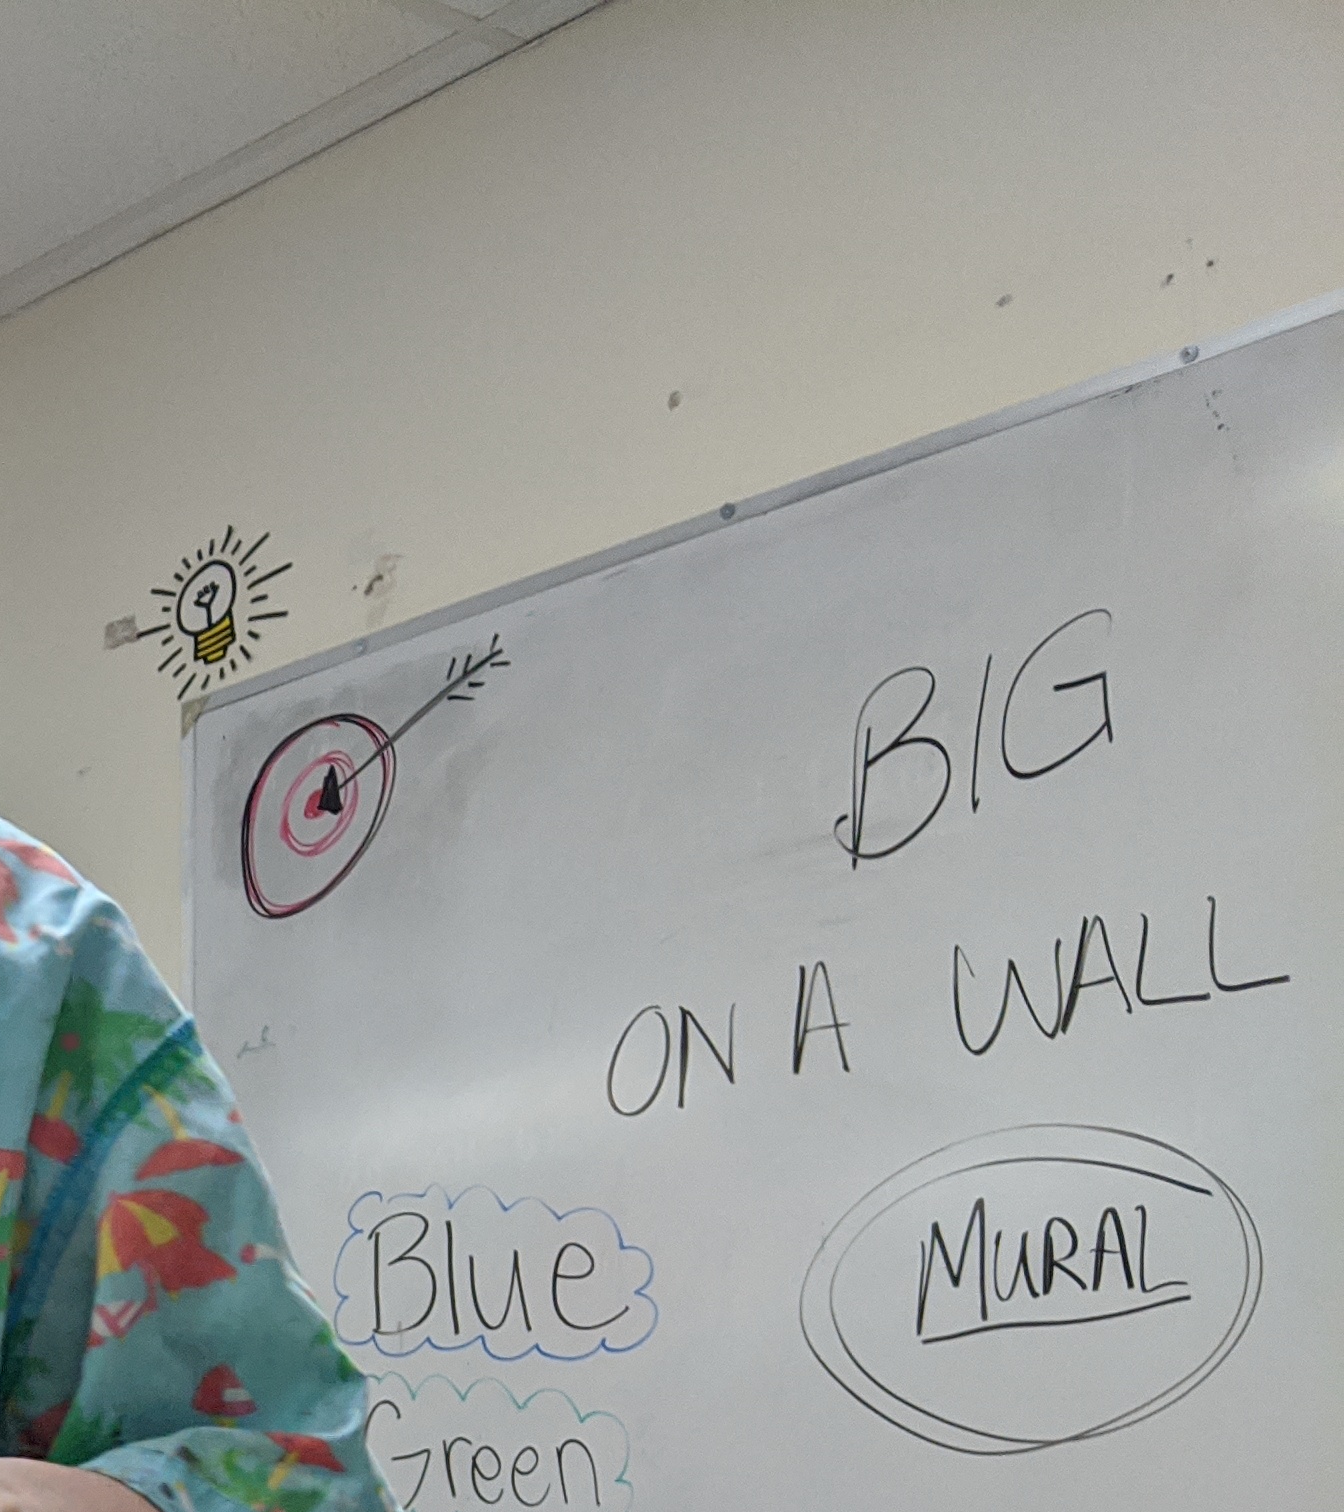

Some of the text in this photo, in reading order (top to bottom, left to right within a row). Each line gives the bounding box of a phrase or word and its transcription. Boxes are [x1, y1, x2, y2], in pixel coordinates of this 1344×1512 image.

[834, 608, 1113, 870] BIG
[607, 896, 1291, 1115] ON A WALL
[368, 1211, 630, 1335] Blue
[917, 1197, 1188, 1336] MURAL
[365, 1400, 601, 1510] Green
